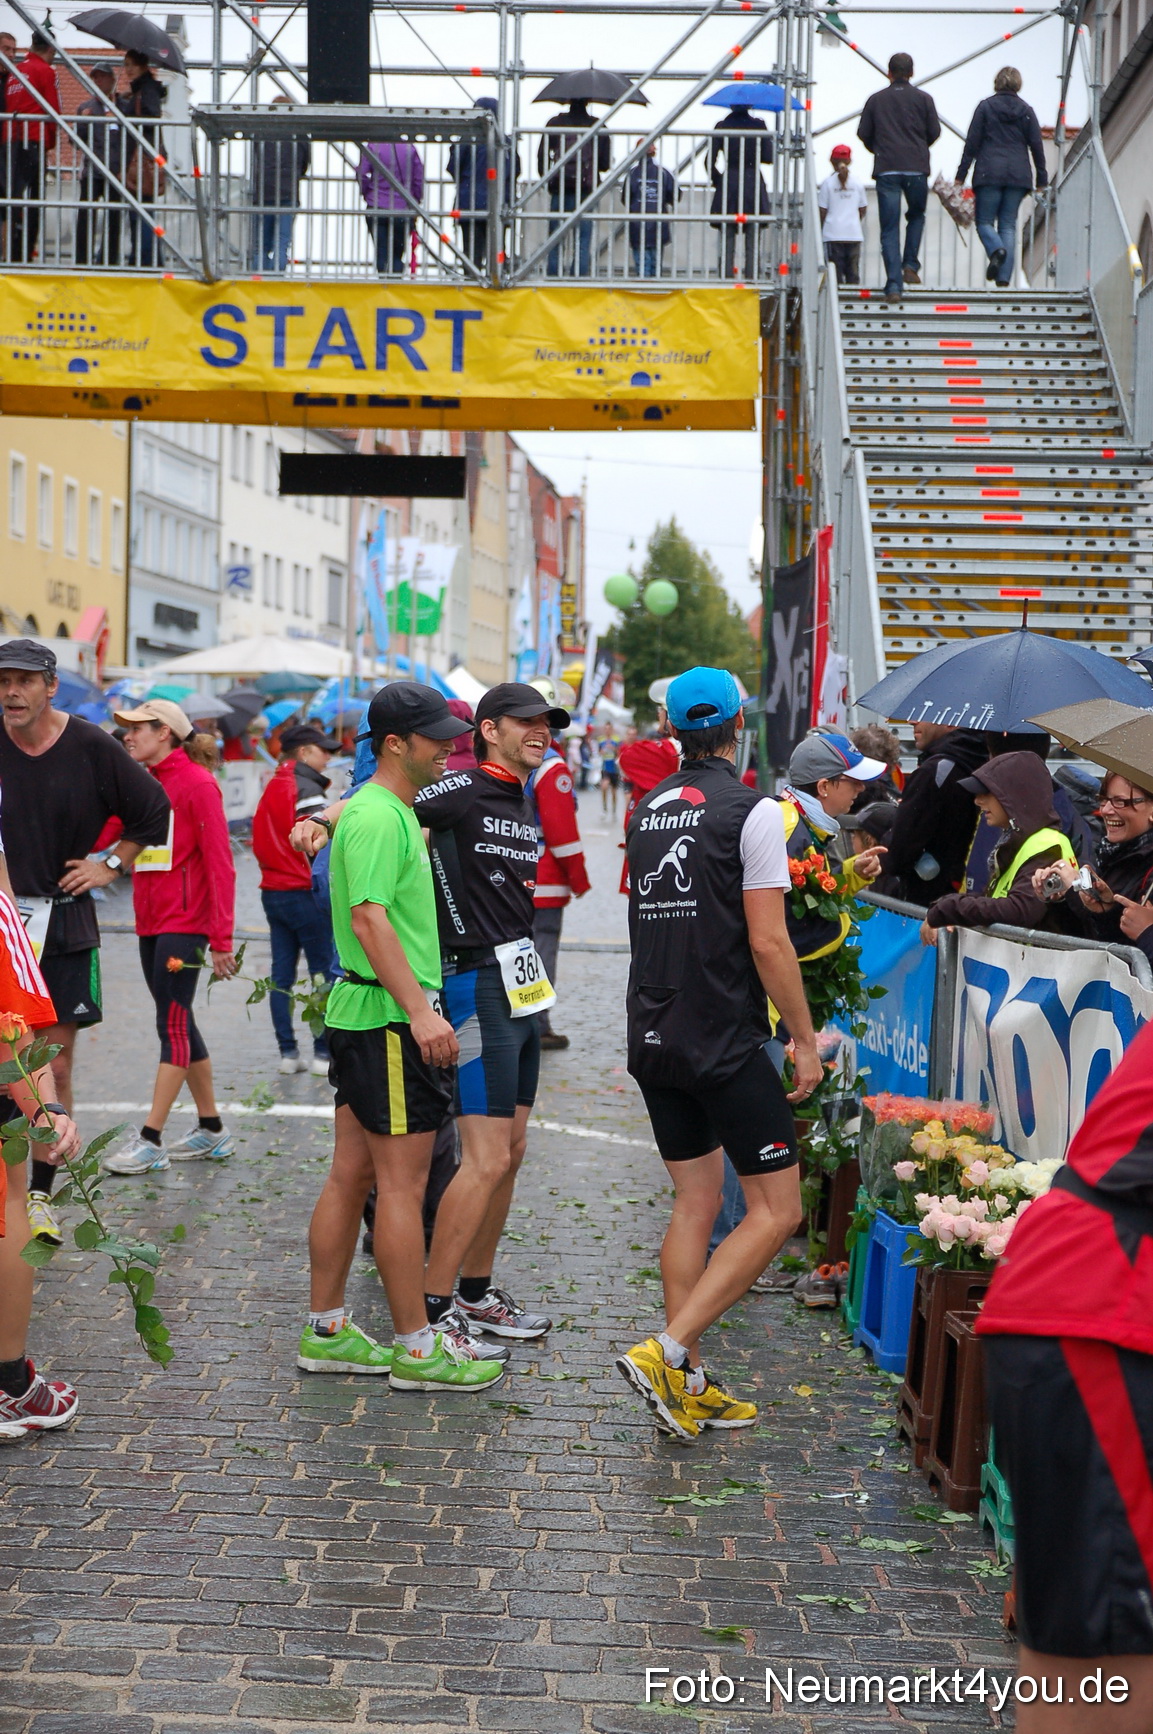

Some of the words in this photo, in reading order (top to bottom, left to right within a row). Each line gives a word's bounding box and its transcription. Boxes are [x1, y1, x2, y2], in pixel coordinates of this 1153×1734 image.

[0, 333, 69, 348] markter
[74, 335, 150, 351] Stadtlauf
[199, 303, 483, 373] START
[534, 349, 631, 363] Neumarkter
[636, 350, 713, 365] Stadtlauf
[482, 816, 538, 842] SIEMENS
[640, 809, 703, 831] skinfit
[432, 848, 466, 935] cannondale
[760, 1148, 790, 1161] skinfit
